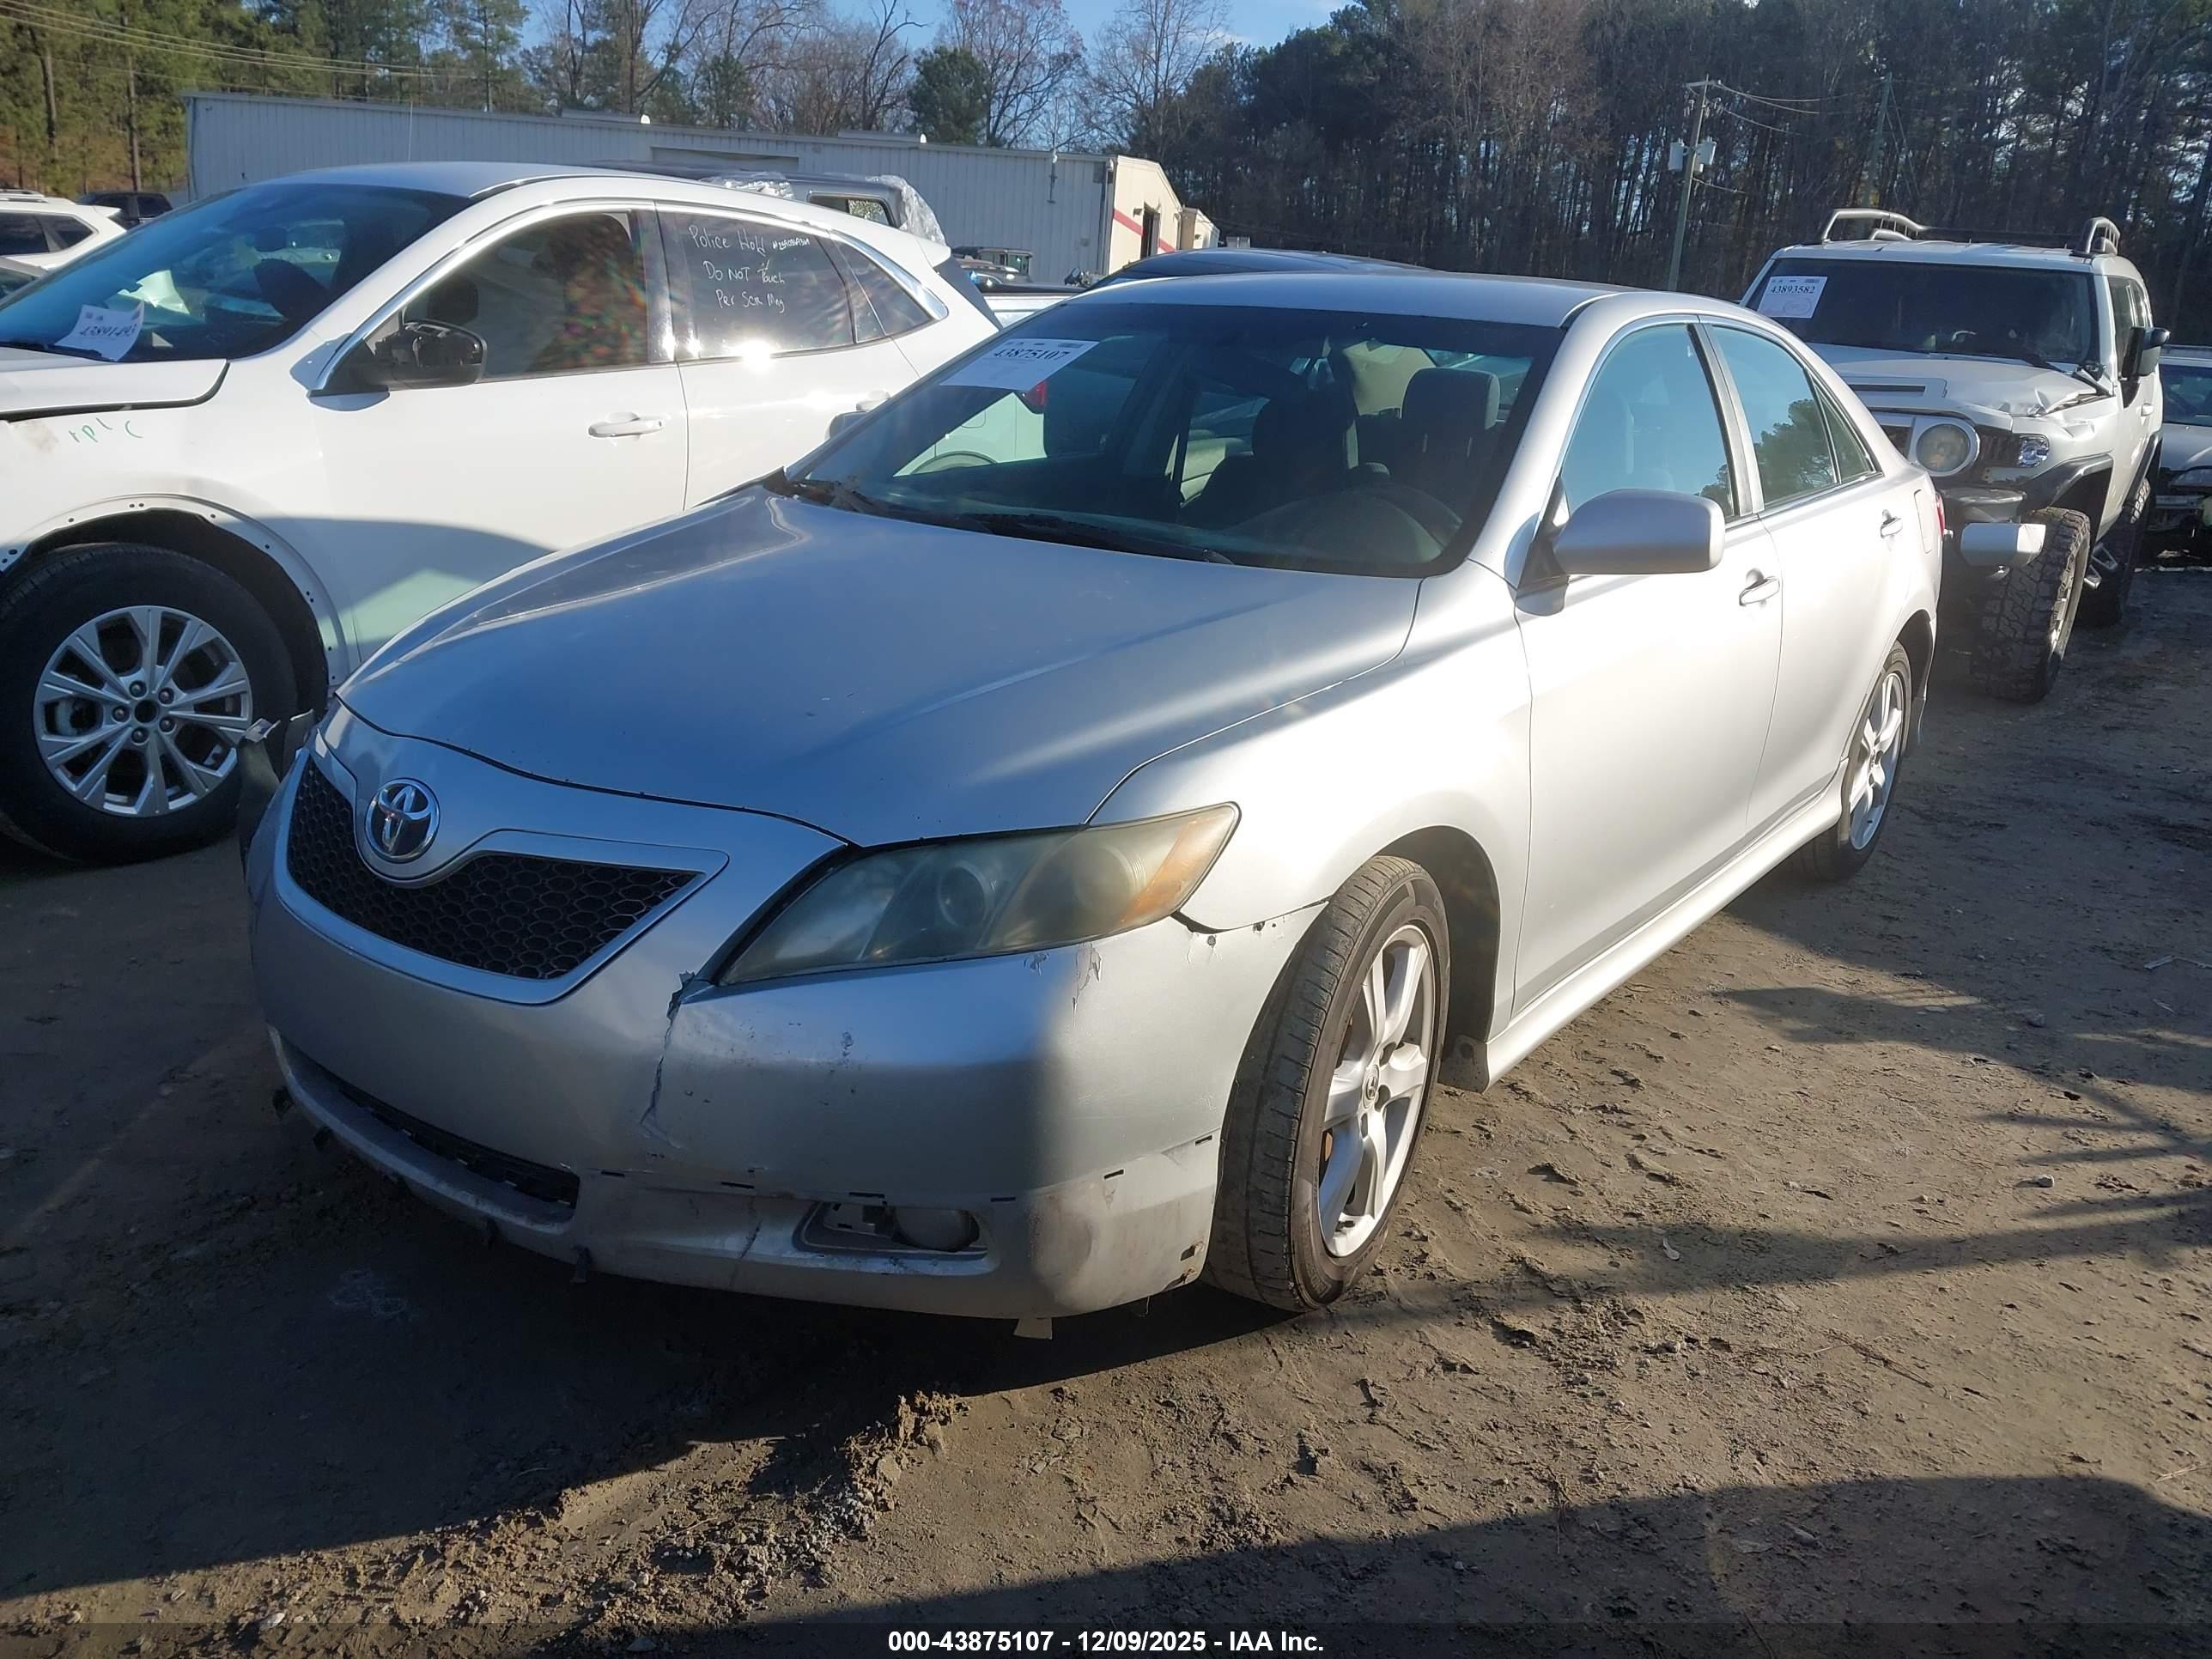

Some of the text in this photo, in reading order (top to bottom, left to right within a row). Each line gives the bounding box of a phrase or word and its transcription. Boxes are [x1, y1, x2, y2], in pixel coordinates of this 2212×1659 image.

[688, 224, 731, 249] Police
[702, 260, 723, 281] Do
[728, 266, 750, 282] NOT
[715, 289, 735, 309] Per
[1771, 284, 1816, 294] 43893582
[994, 349, 1070, 360] 43875107
